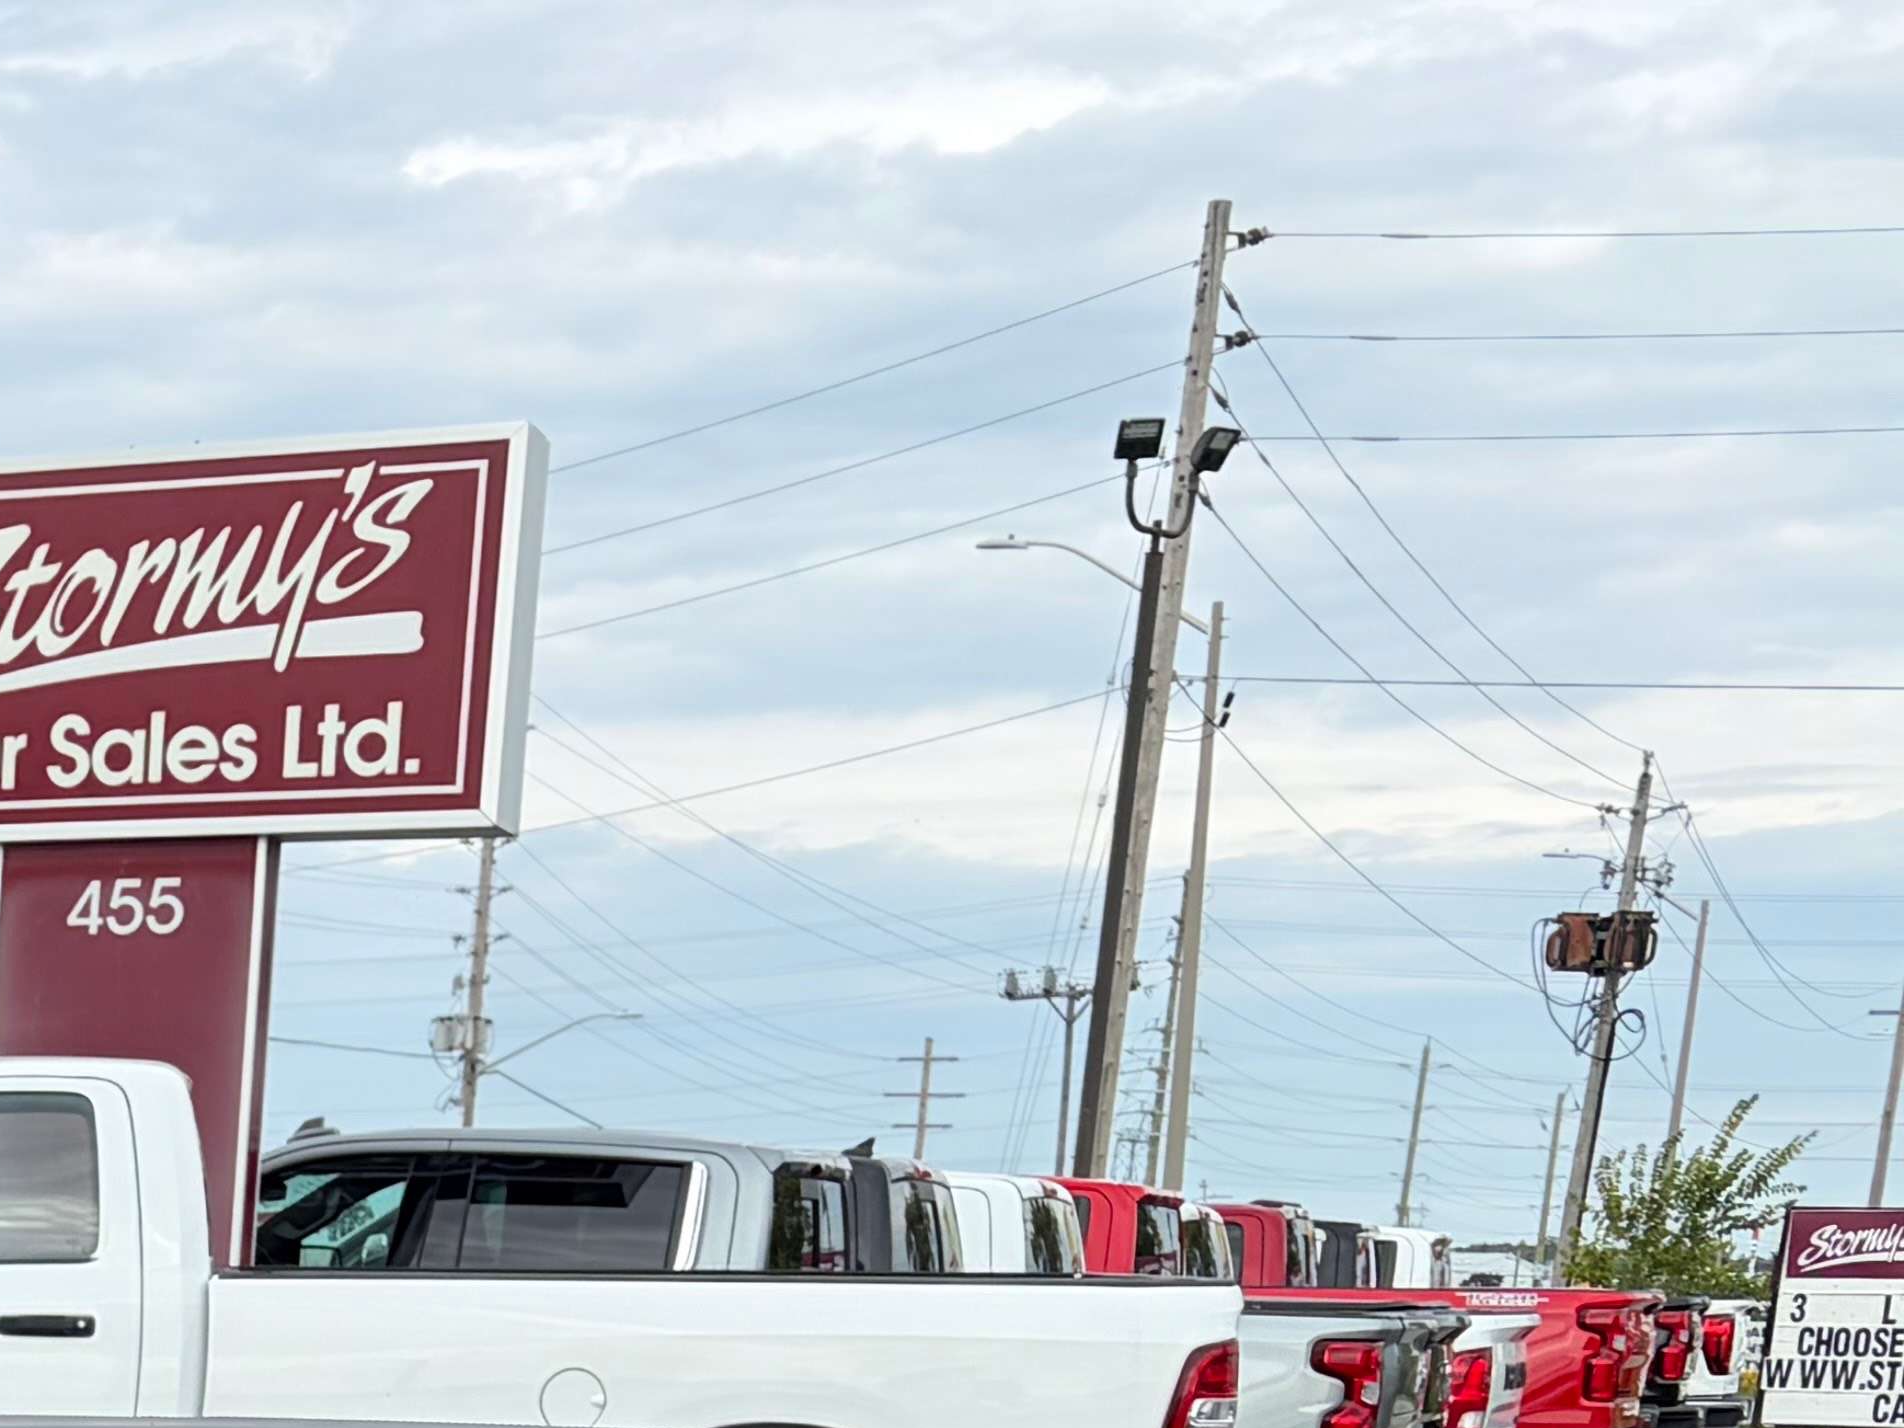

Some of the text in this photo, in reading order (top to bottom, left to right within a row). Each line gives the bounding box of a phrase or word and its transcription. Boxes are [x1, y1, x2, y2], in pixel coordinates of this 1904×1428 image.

[46, 714, 258, 789] Sales
[281, 701, 421, 780] Ltd.
[65, 877, 184, 937] 455
[1790, 1293, 1897, 1325] 3 L
[1797, 1327, 1904, 1357] CHOOSE
